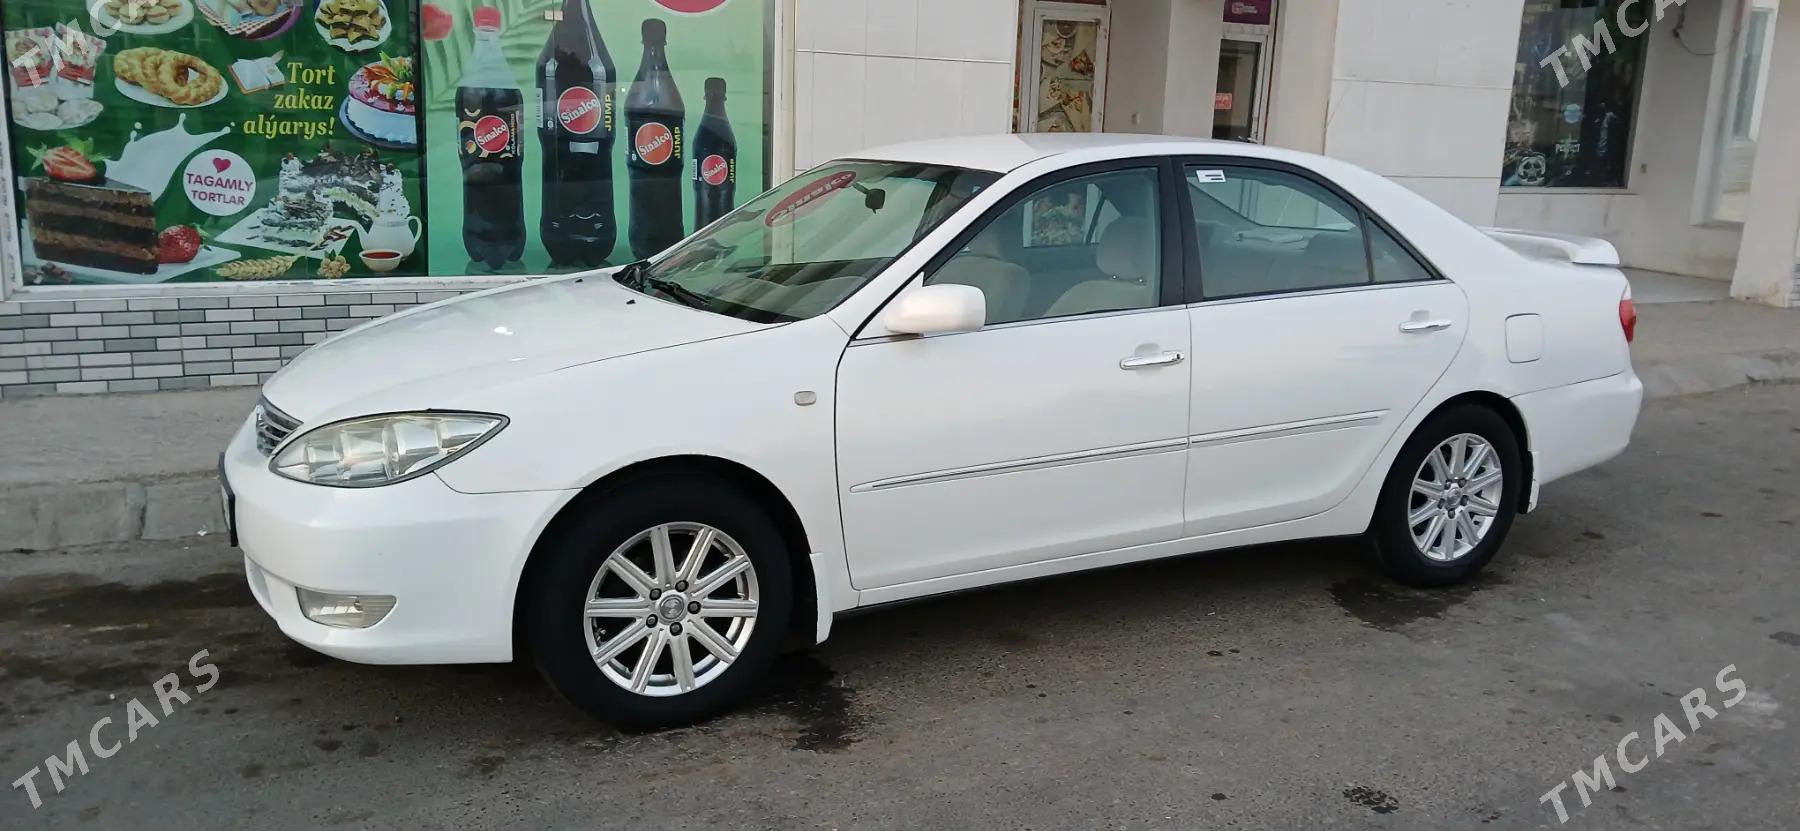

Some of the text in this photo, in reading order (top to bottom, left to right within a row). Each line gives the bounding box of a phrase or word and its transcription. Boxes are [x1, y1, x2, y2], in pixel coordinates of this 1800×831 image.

[287, 62, 336, 85] Tort
[274, 88, 334, 110] zakaz
[561, 98, 599, 123] Sinalco
[604, 94, 612, 132] JUMP
[243, 114, 335, 140] alýarys!
[477, 124, 507, 145] Sinalco
[638, 131, 671, 156] Sinalco
[703, 162, 727, 179] Sinalco
[186, 172, 254, 192] TAGAMLY
[191, 190, 245, 206] TORTLAR
